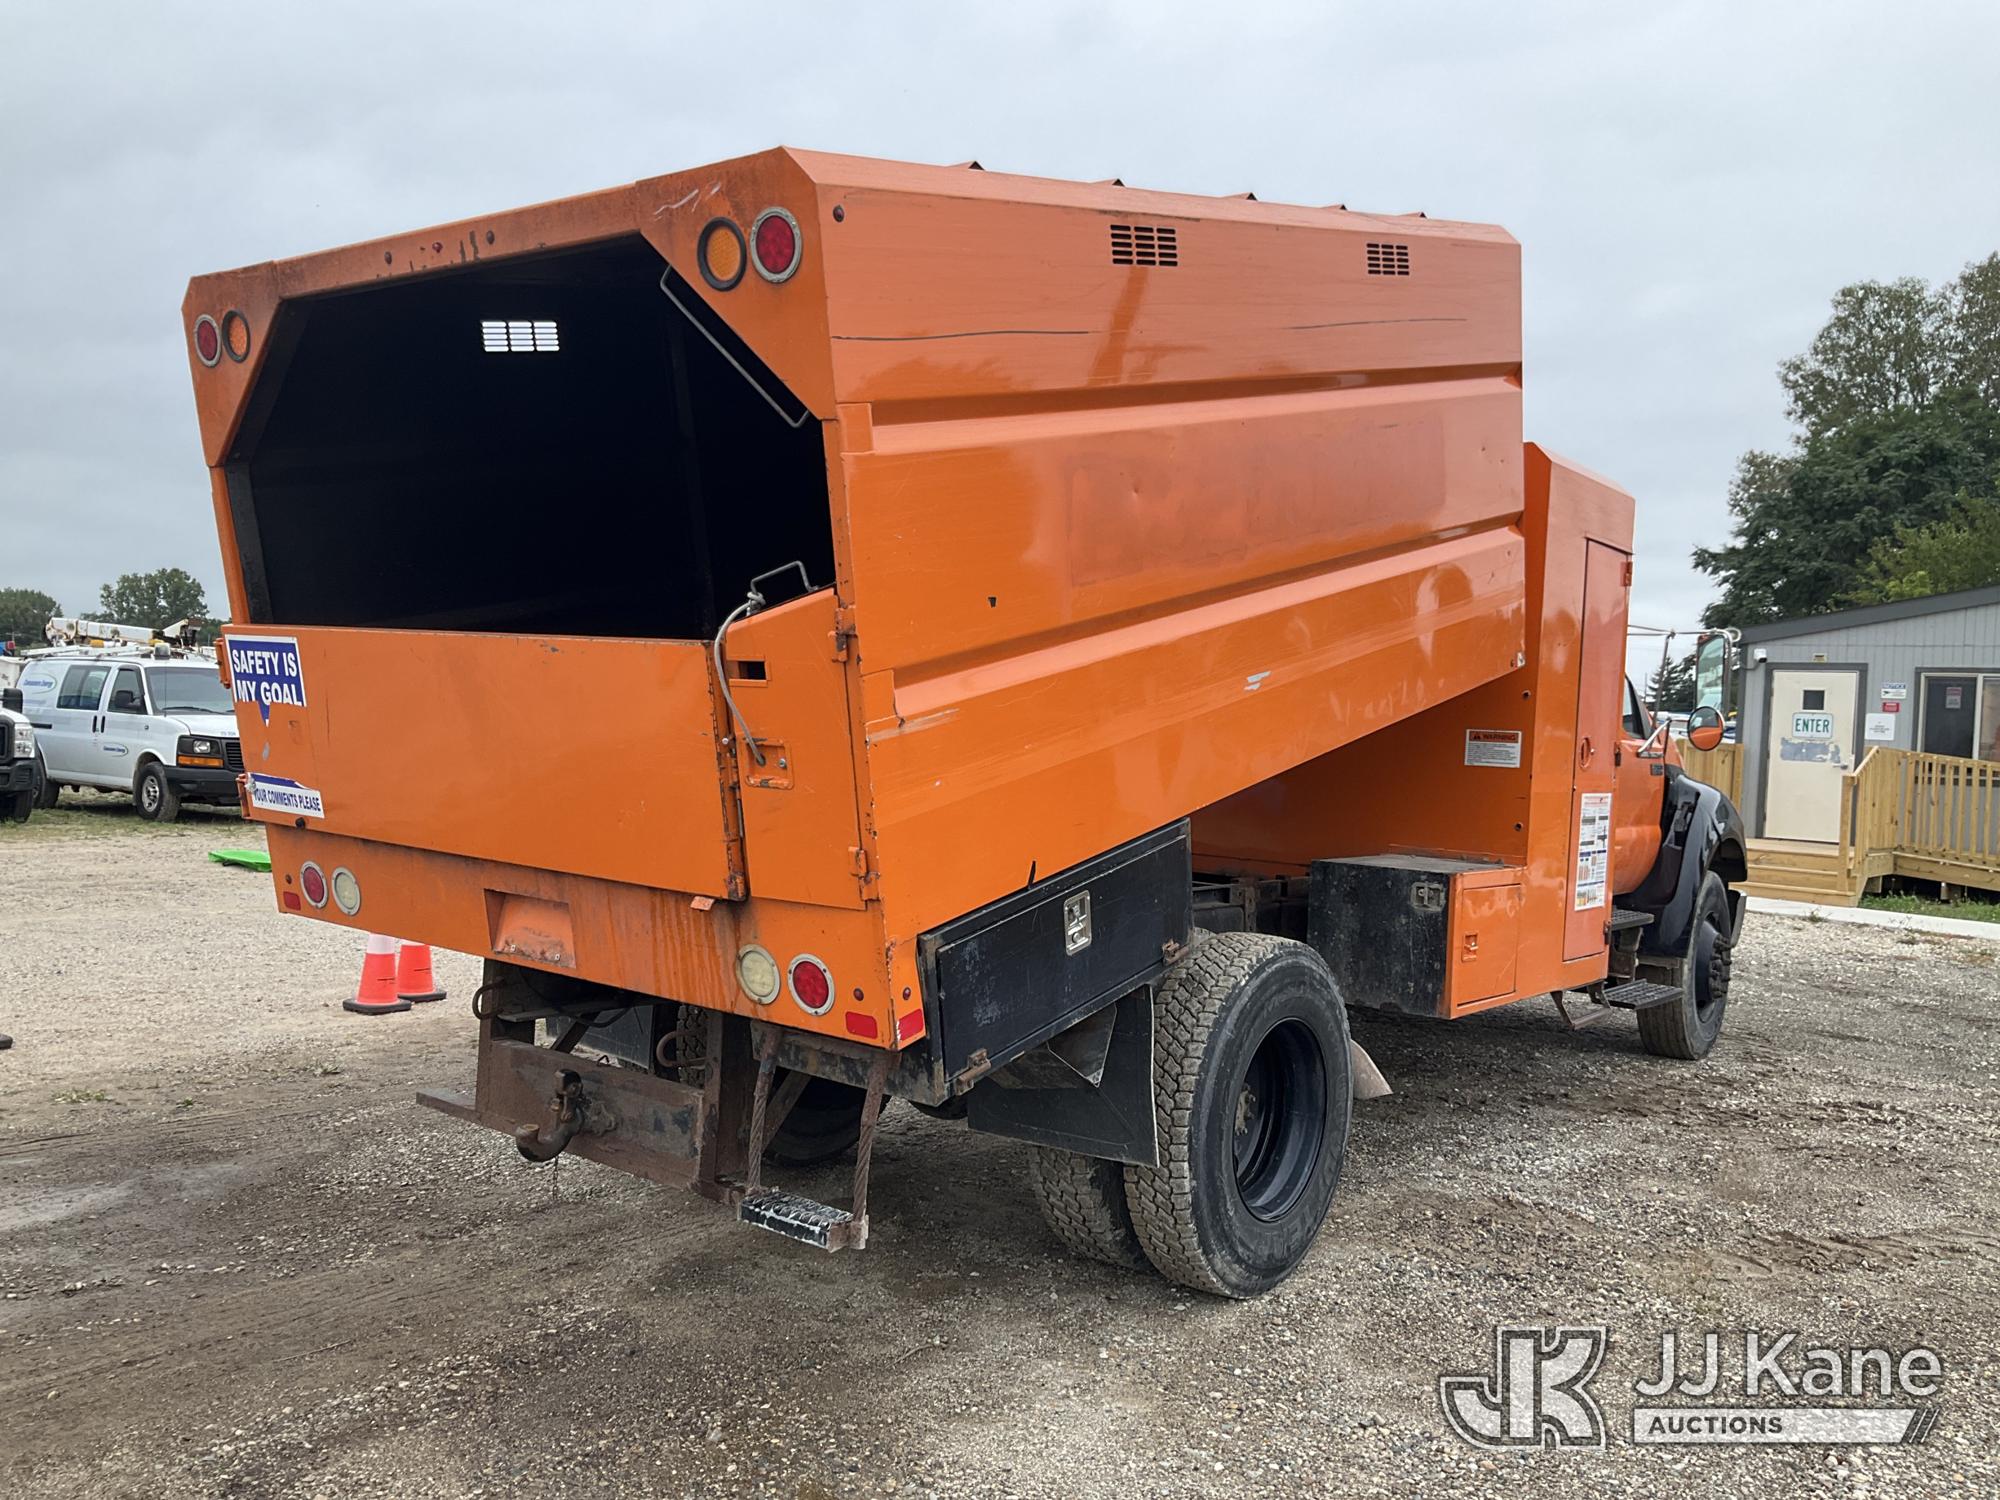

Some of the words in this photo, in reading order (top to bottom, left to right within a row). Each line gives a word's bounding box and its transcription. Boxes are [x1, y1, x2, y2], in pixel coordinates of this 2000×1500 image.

[232, 649, 279, 676] SAFETY
[282, 652, 298, 677] IS
[236, 680, 257, 702] MY
[260, 681, 303, 706] GOAL
[1795, 718, 1830, 733] ENTER
[267, 790, 299, 809] COMMENTS
[299, 794, 322, 812] PLEASE
